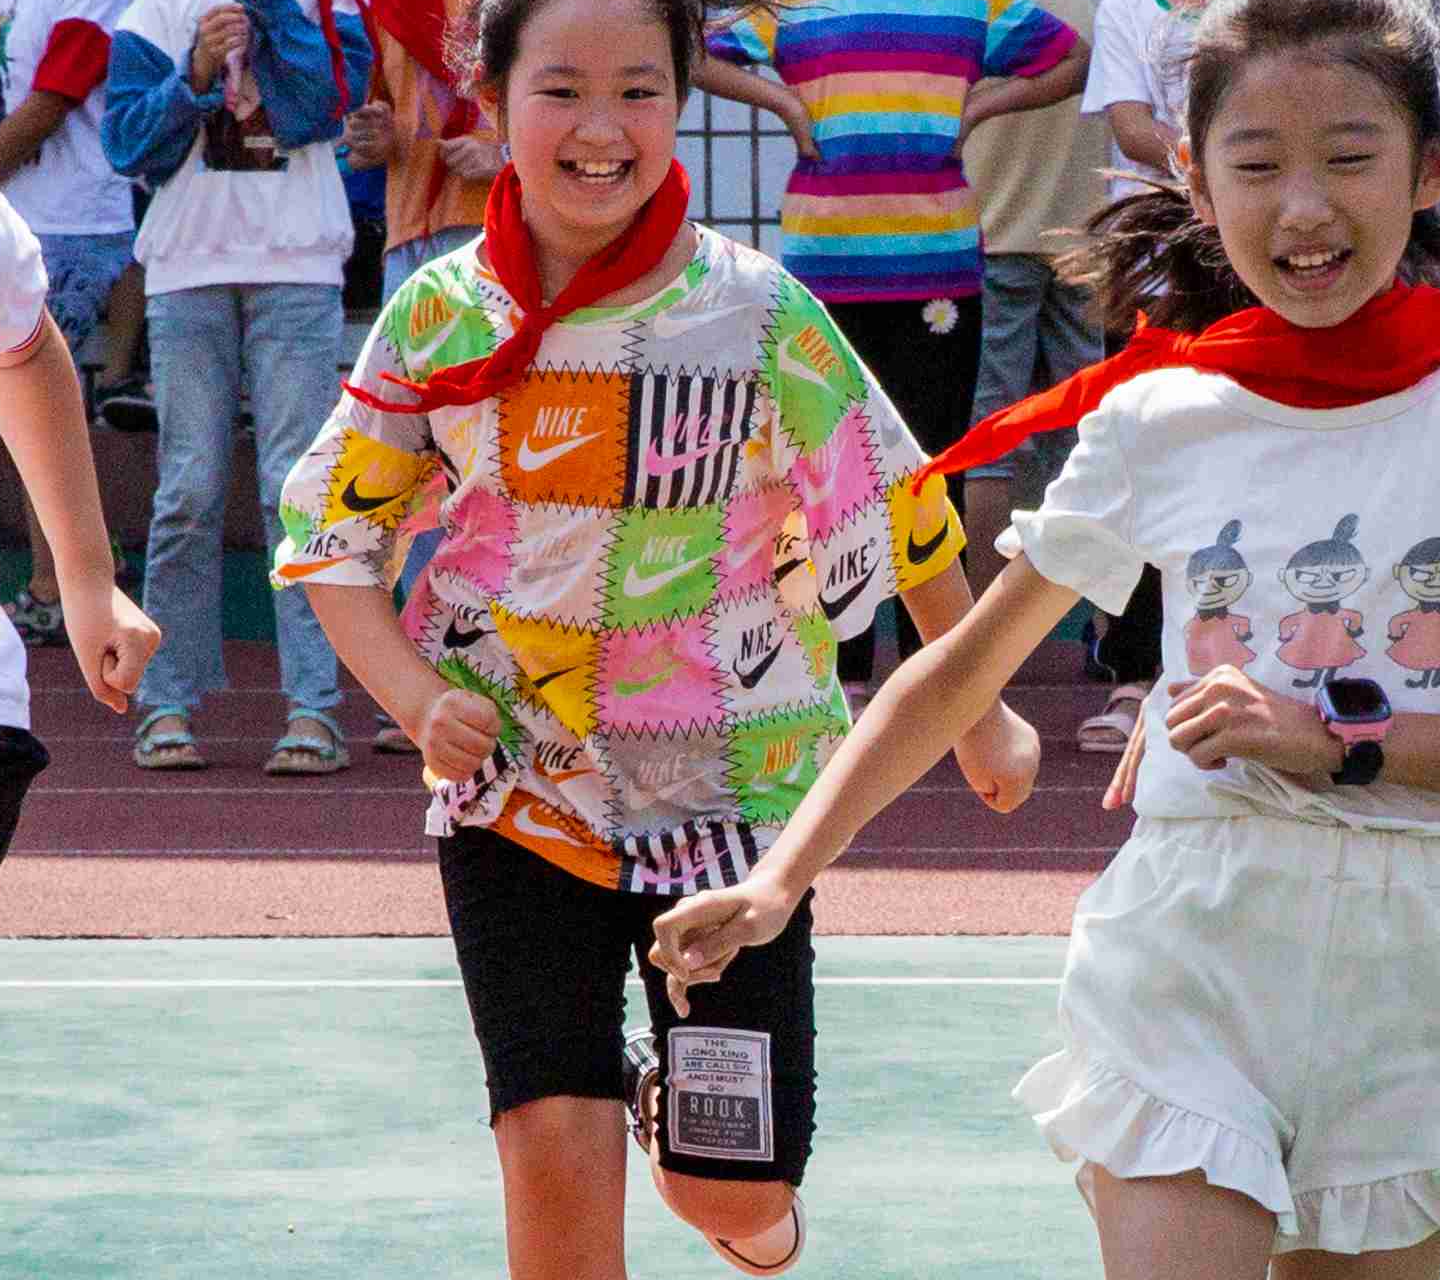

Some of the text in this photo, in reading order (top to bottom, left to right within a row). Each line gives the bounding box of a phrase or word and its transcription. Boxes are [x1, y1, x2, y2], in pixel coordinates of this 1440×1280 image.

[532, 406, 587, 438] NIKE
[640, 534, 692, 565] NIKE
[534, 740, 584, 770] NIKE
[763, 733, 801, 776] NIKE
[703, 1039, 729, 1049] THE
